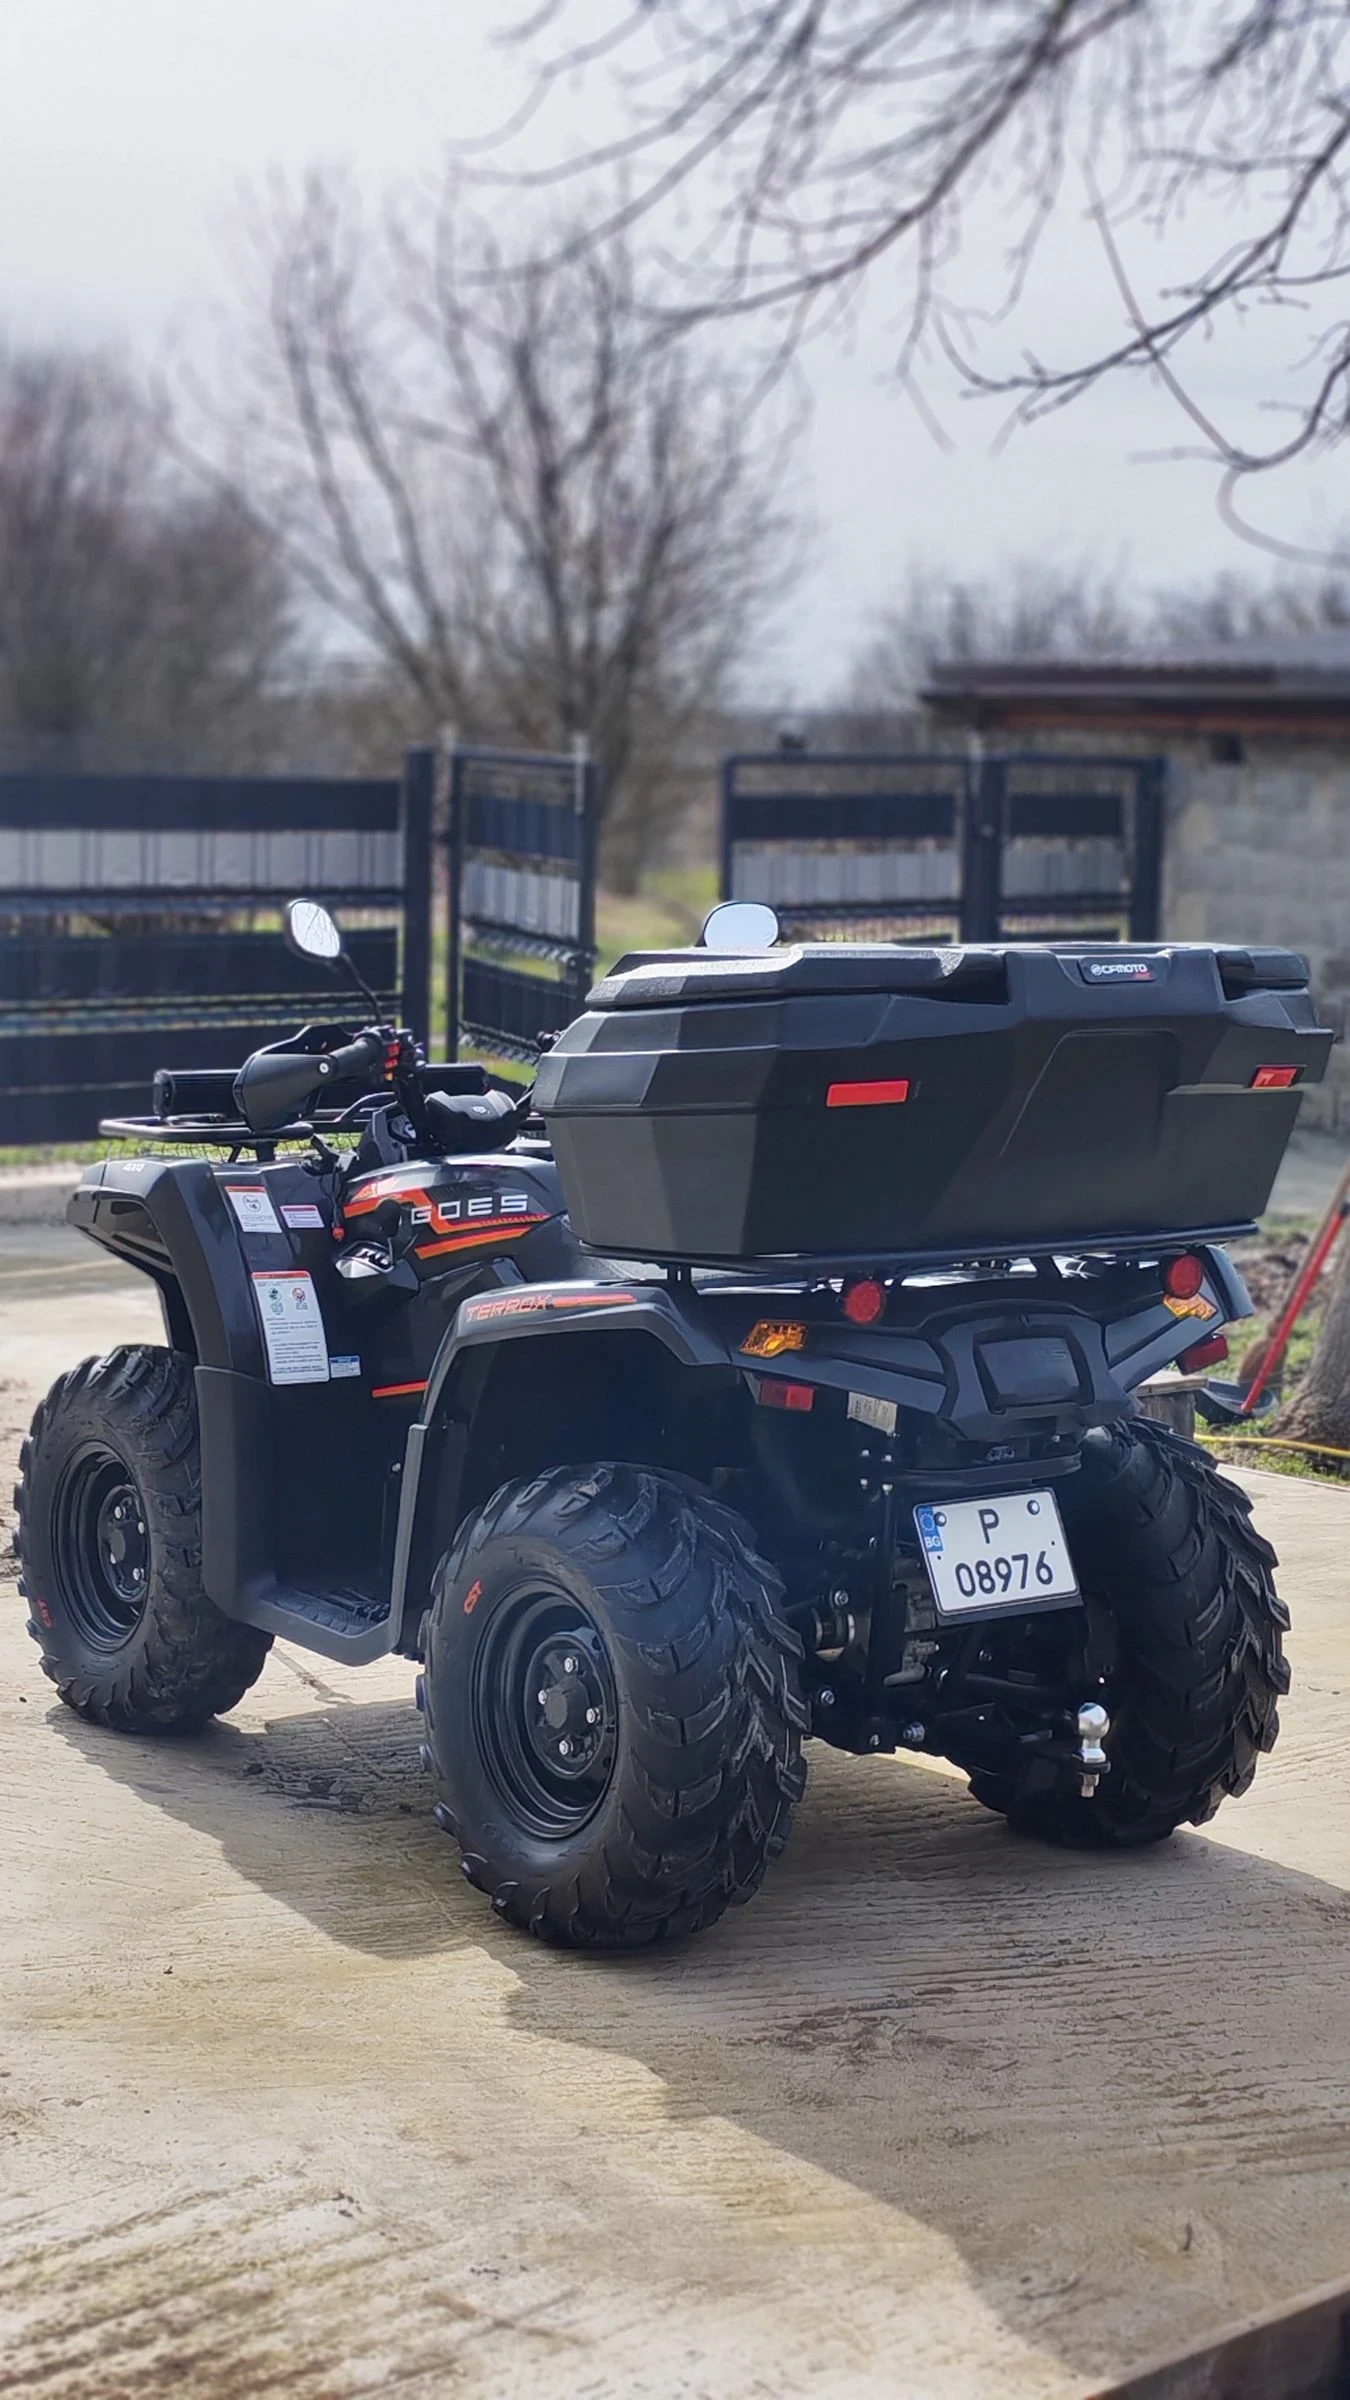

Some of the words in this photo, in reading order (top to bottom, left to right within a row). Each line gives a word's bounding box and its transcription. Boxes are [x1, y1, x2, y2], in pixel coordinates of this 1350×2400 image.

[1101, 963, 1149, 975] CFMOTO
[411, 1194, 528, 1225] GOES
[978, 1508, 1000, 1544] P
[924, 1535, 942, 1549] BG
[955, 1550, 1054, 1598] 08976
